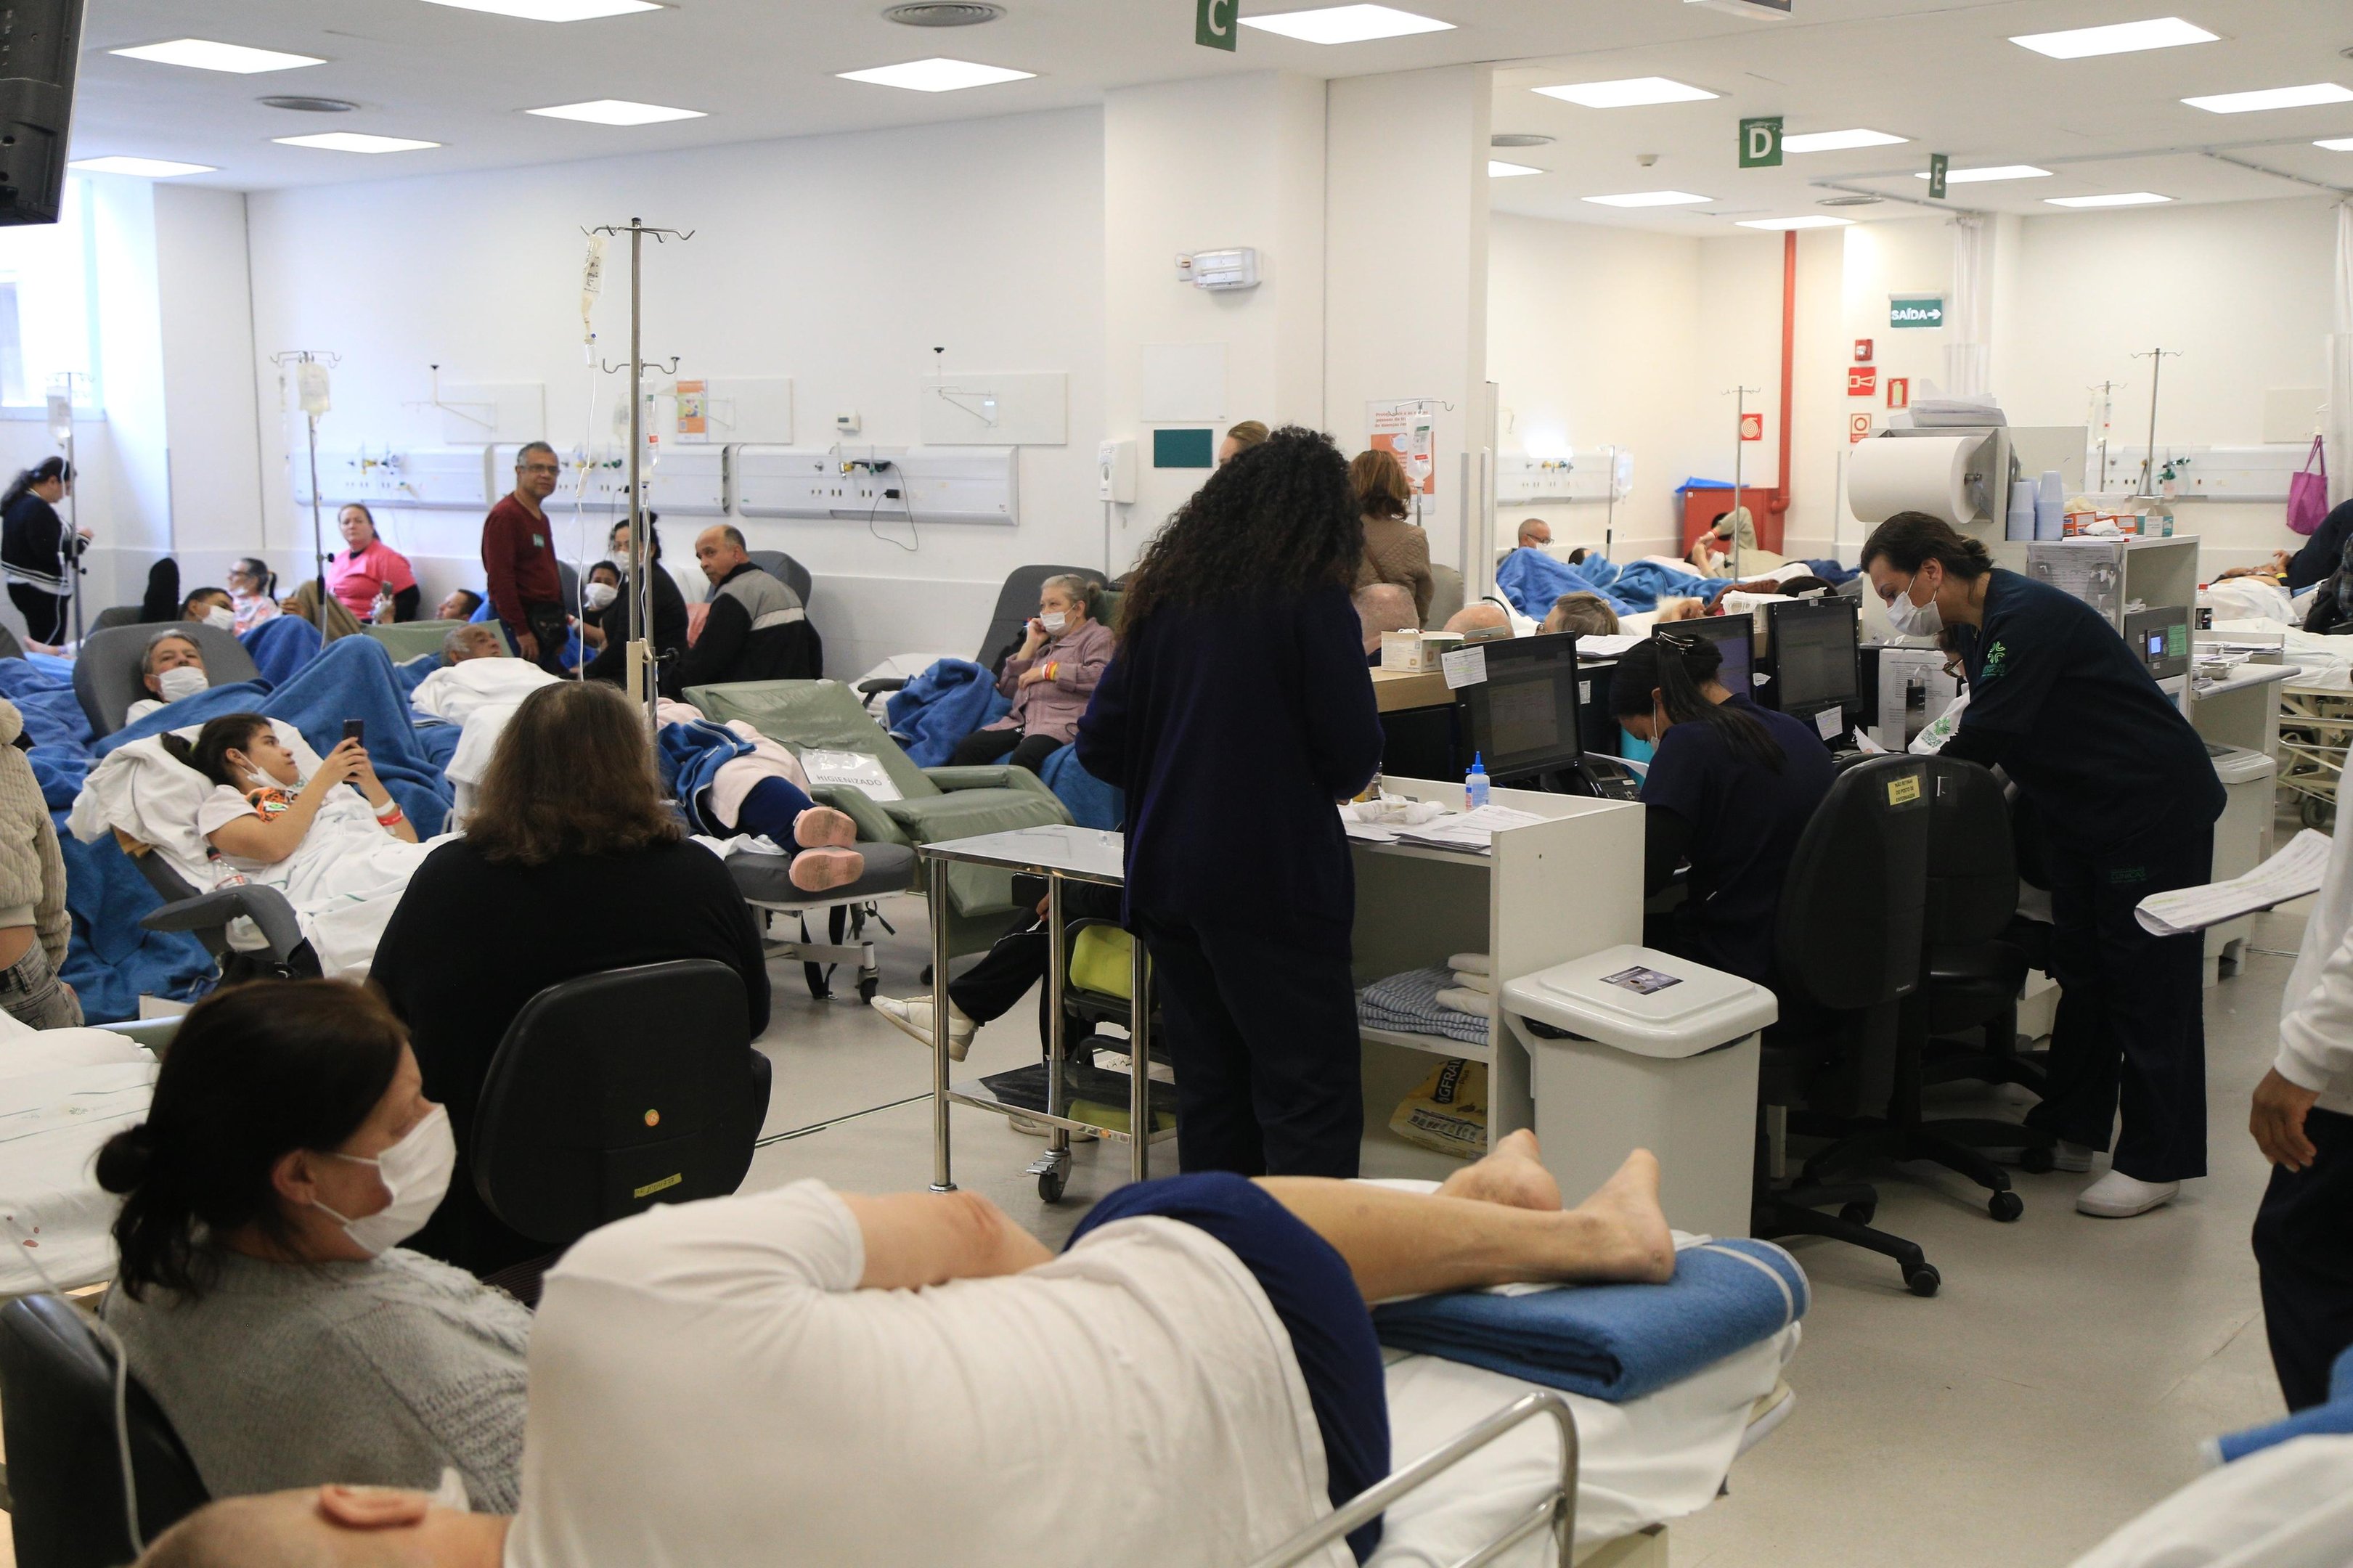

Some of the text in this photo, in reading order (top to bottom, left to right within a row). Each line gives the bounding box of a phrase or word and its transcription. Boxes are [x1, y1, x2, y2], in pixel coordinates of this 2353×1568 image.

[1208, 0, 1228, 36] C
[1749, 127, 1773, 158] D
[1934, 163, 1943, 189] E
[1891, 307, 1928, 320] SAÍDA
[817, 775, 883, 786] HIGIENIZADO
